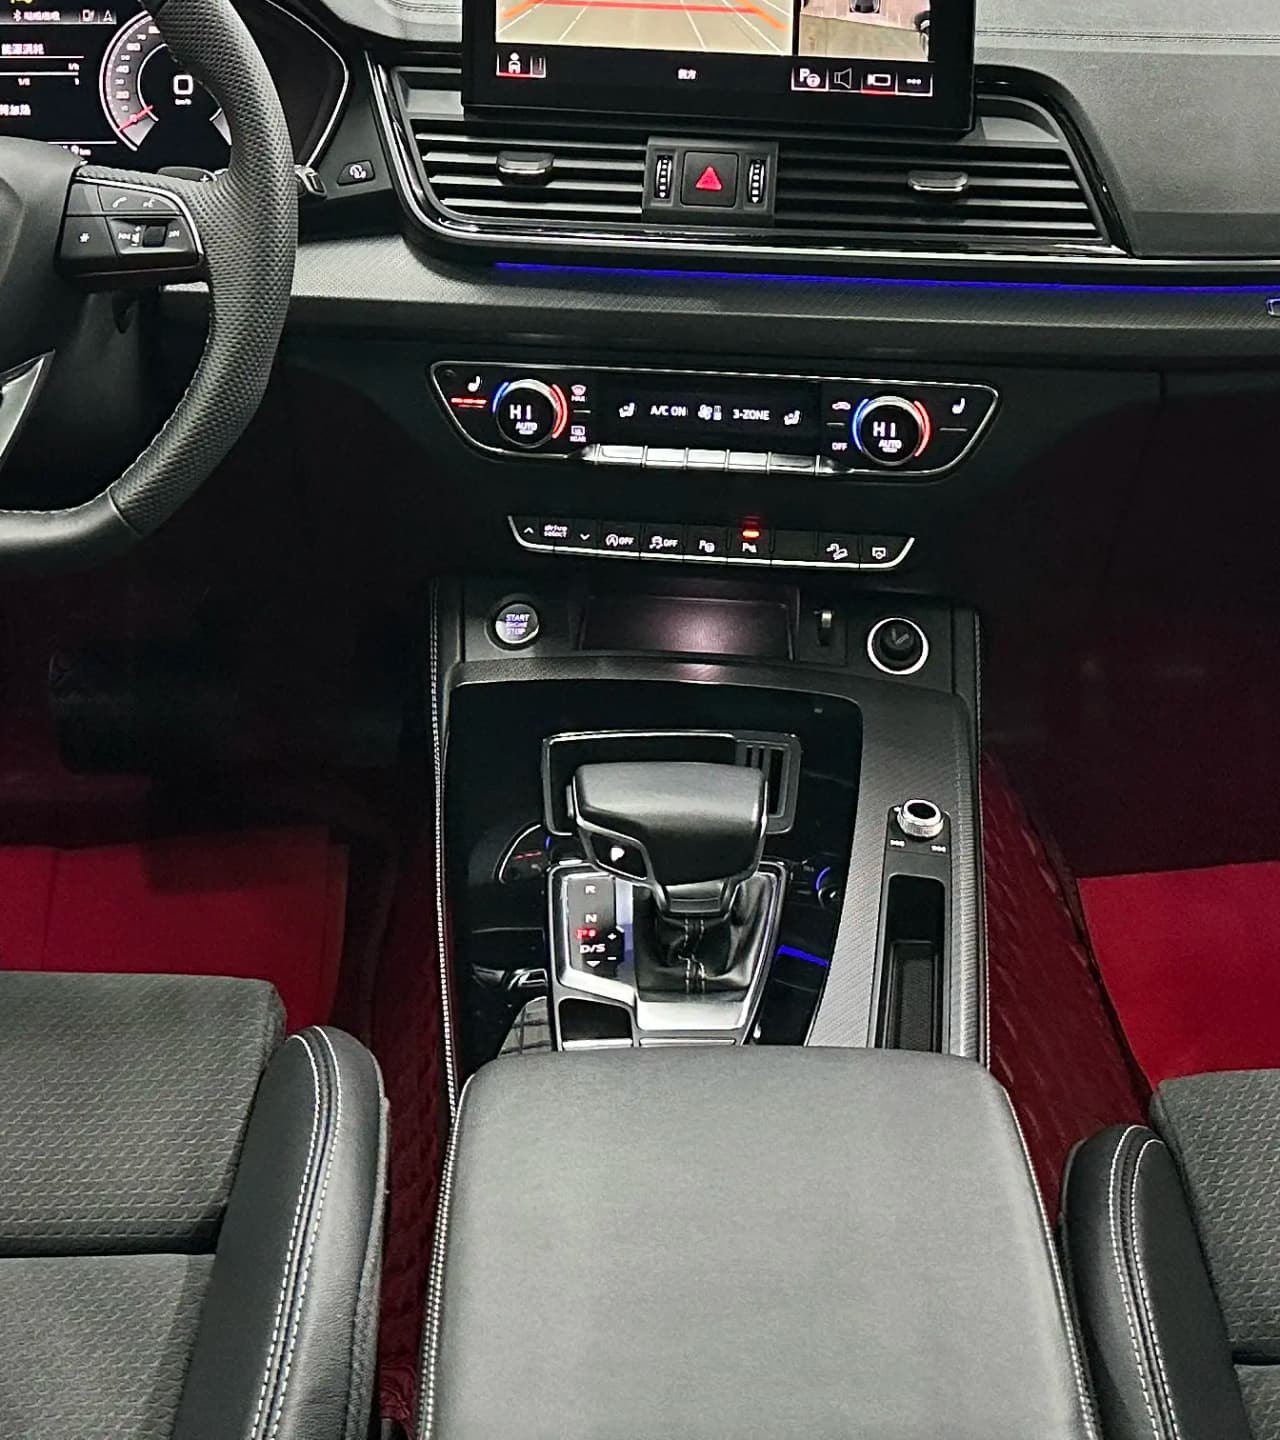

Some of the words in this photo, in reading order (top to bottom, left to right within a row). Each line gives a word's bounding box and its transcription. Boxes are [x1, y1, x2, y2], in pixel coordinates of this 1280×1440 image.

[173, 74, 194, 95] 0
[509, 404, 533, 420] HI
[650, 405, 670, 416] A/C
[670, 406, 687, 417] ON
[732, 408, 771, 421] 3-ZONE
[872, 421, 897, 438] HI
[832, 442, 848, 451] OFF
[619, 537, 634, 546] OFF
[663, 539, 678, 548] OFF
[506, 613, 530, 622] START
[584, 884, 596, 895] R
[585, 913, 597, 924] N
[579, 943, 606, 954] D/S
